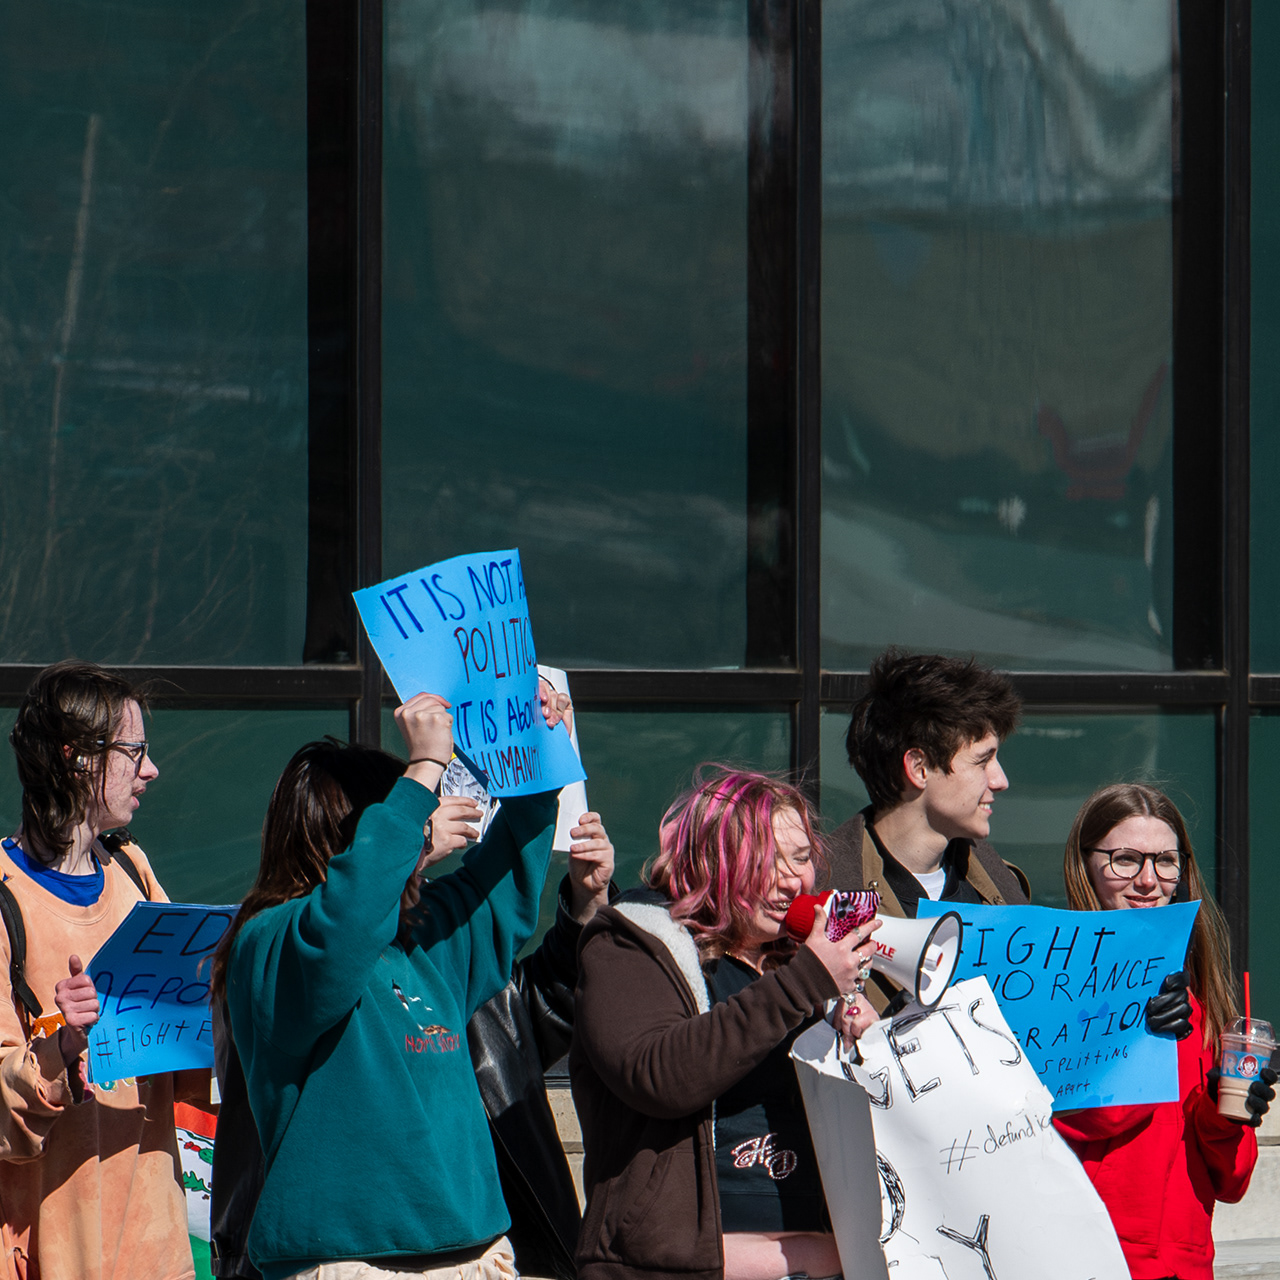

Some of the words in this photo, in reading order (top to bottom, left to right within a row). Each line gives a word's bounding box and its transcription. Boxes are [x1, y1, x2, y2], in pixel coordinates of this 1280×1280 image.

[380, 583, 424, 640] IT
[420, 573, 466, 621] IS
[466, 558, 514, 611] NOT
[456, 700, 473, 751] IT
[480, 698, 498, 745] IS
